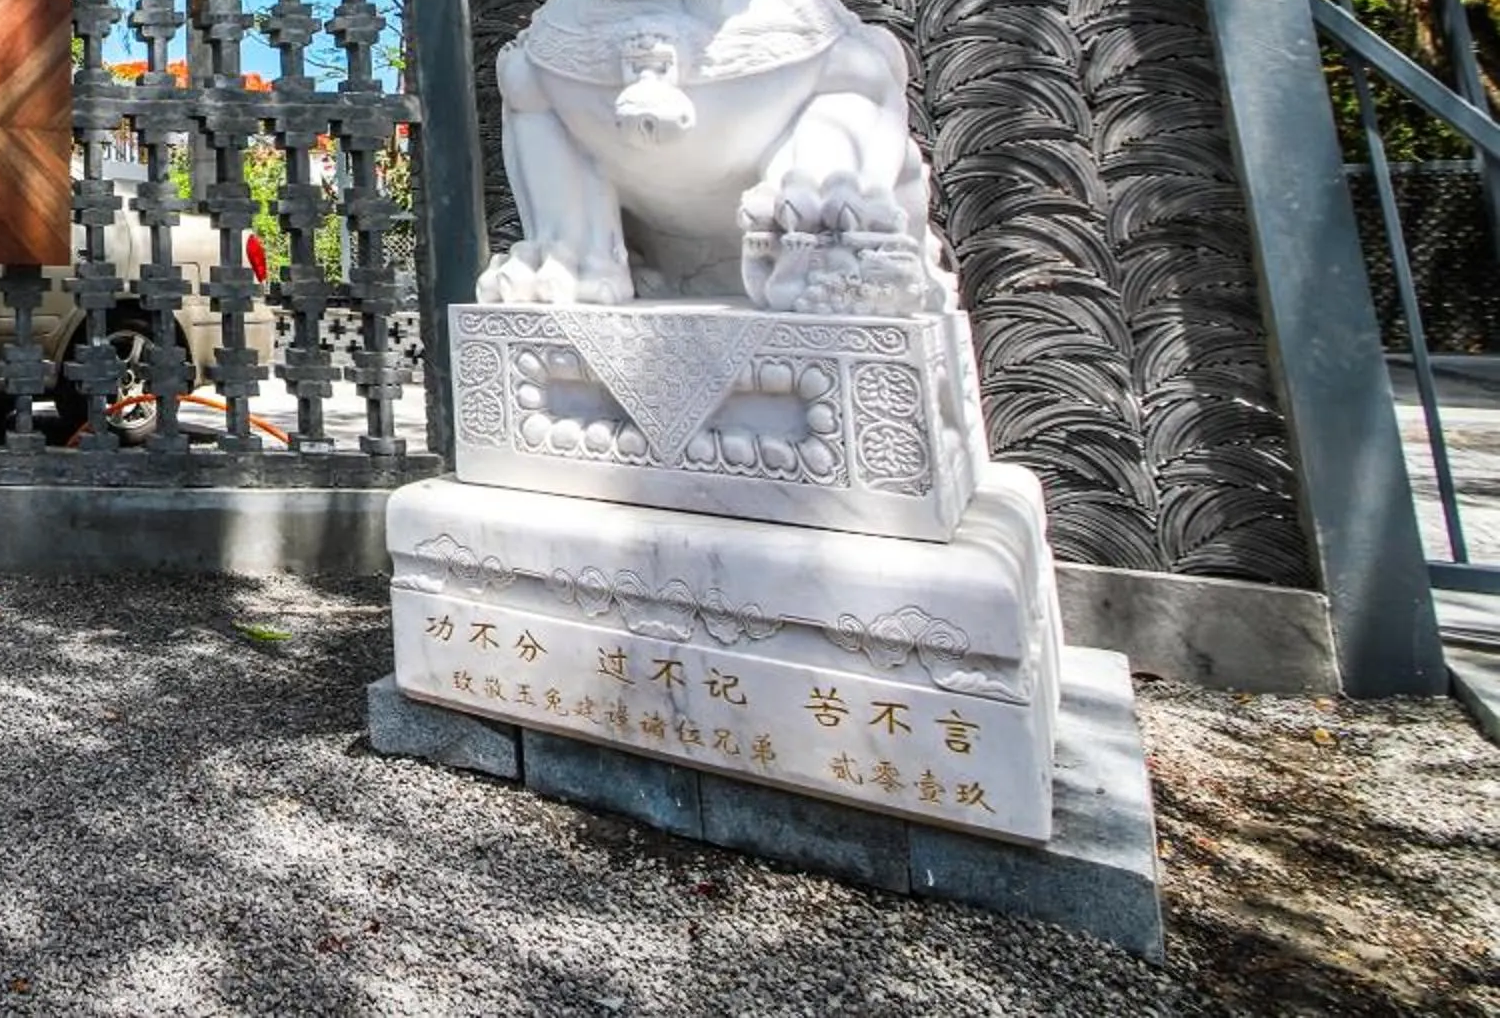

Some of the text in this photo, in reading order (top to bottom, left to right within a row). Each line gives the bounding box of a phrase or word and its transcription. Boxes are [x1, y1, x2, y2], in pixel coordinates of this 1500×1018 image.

[425, 614, 980, 755] 功不分 过不记 苦不言
